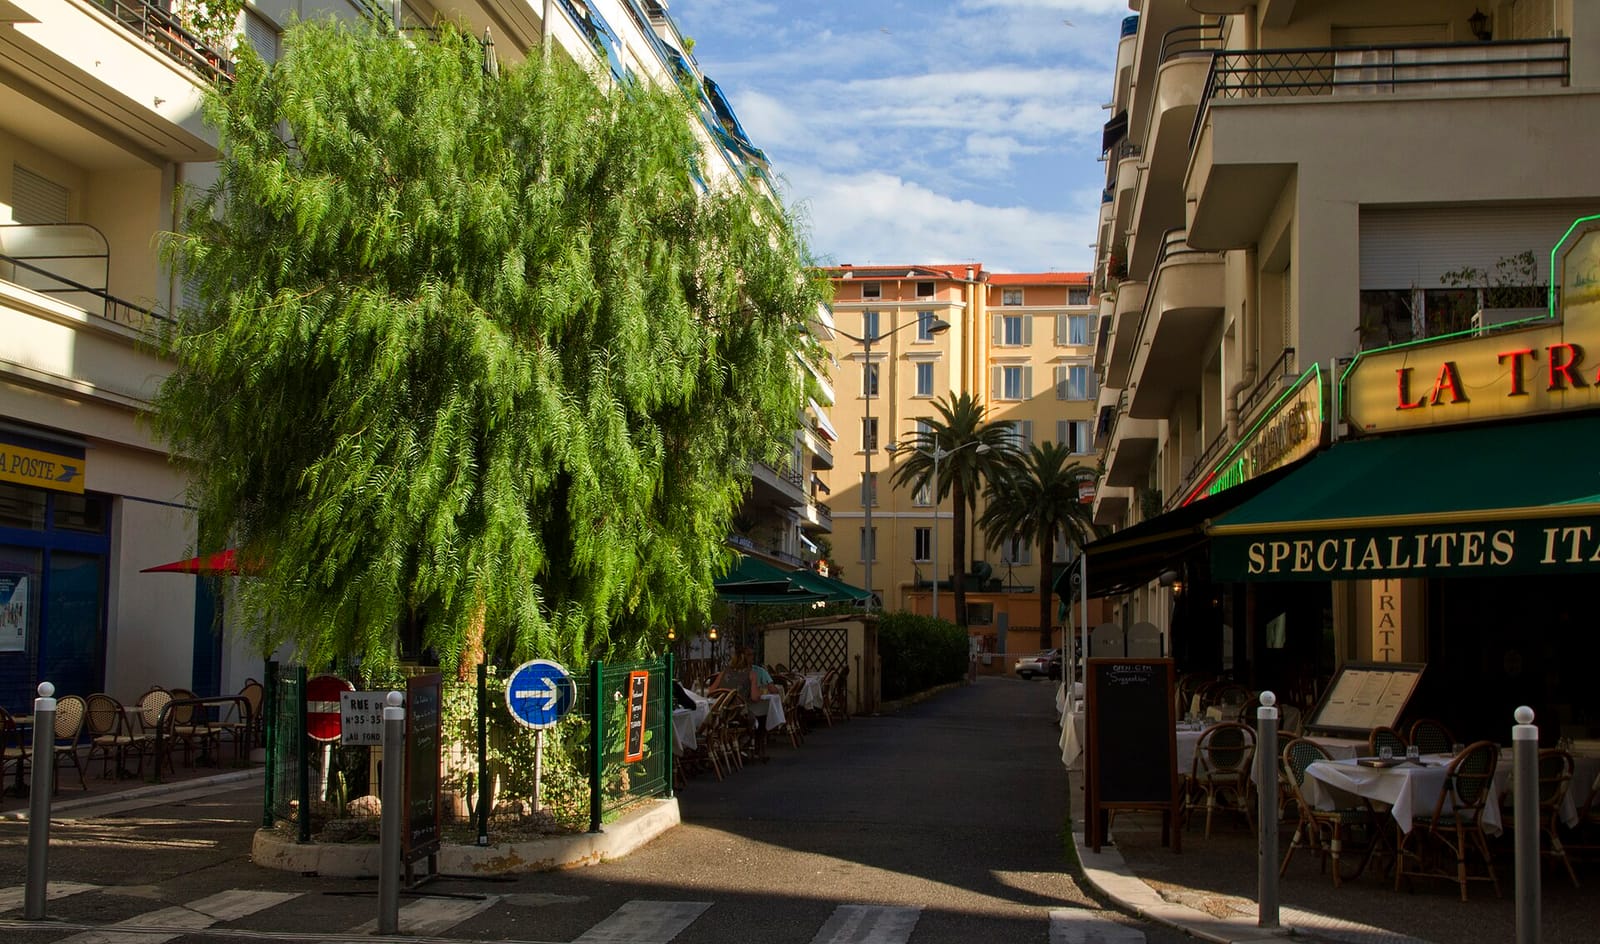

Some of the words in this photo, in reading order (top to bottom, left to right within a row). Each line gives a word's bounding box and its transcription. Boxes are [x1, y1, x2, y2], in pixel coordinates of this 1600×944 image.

[1396, 362, 1471, 411] LA
[1497, 342, 1600, 397] TR
[10, 454, 55, 480] POSTE
[1248, 529, 1516, 574] SPECIALITES
[350, 699, 369, 710] RUE
[374, 702, 384, 710] DE
[350, 732, 359, 741] AU
[362, 732, 381, 741] FOND
